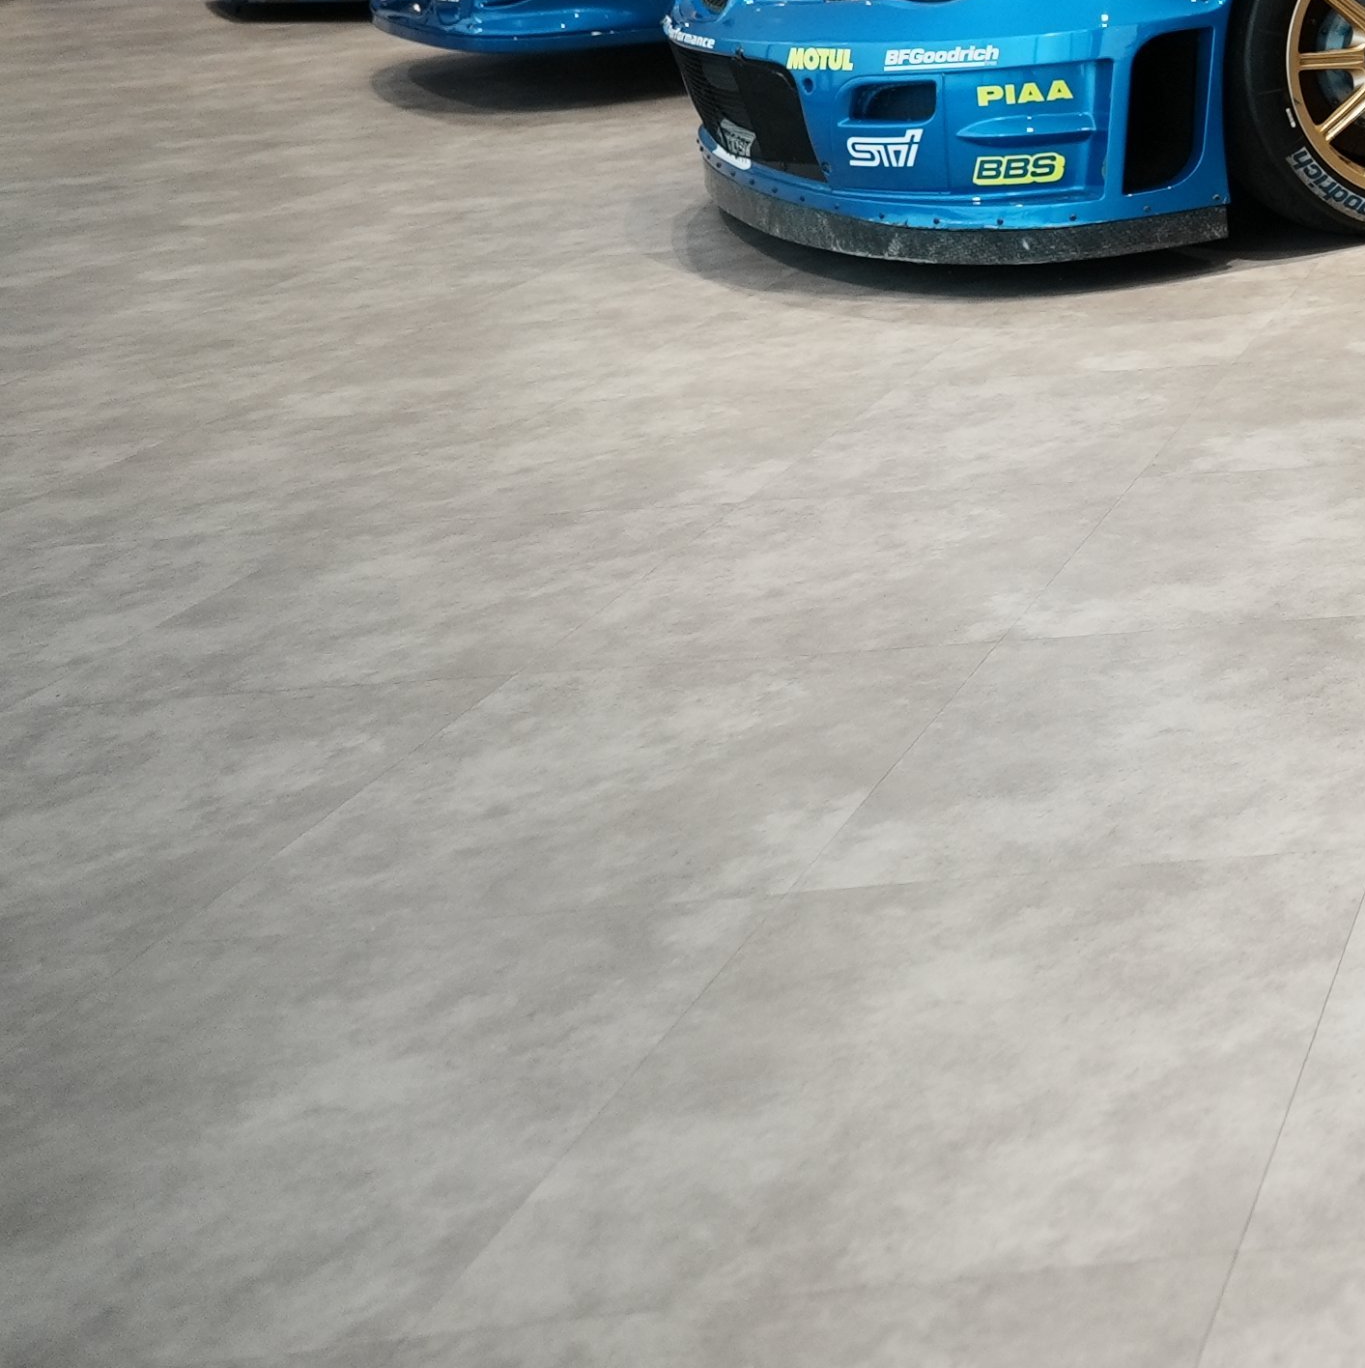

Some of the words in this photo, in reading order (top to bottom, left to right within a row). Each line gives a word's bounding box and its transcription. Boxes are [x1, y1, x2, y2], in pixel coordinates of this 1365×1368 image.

[786, 48, 854, 71] MOTUL
[884, 44, 999, 66] BFGoodrich
[976, 79, 1074, 107] PIAA
[846, 128, 923, 168] STI
[974, 153, 1062, 184] BBS
